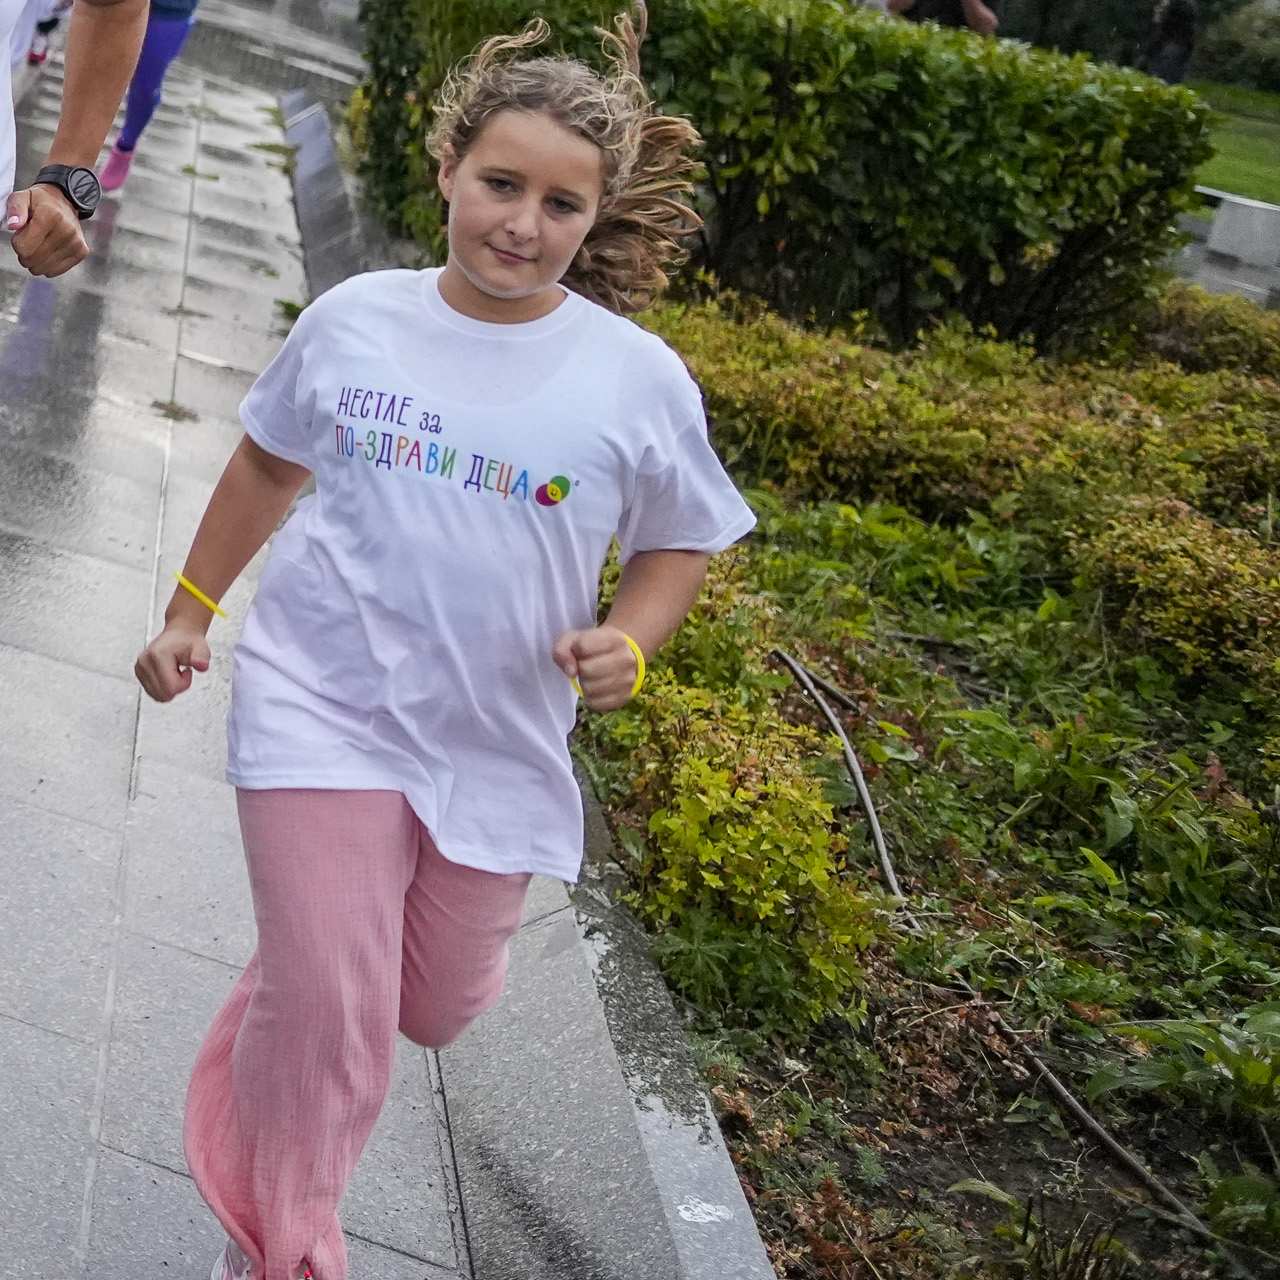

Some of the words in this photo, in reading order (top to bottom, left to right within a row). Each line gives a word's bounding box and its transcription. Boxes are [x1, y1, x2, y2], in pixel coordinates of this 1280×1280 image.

[337, 386, 414, 426] НЕСТЛЕ
[419, 411, 443, 434] за
[335, 424, 457, 480] ПО-ЗДРАВИ
[463, 453, 529, 501] ДЕЦА
